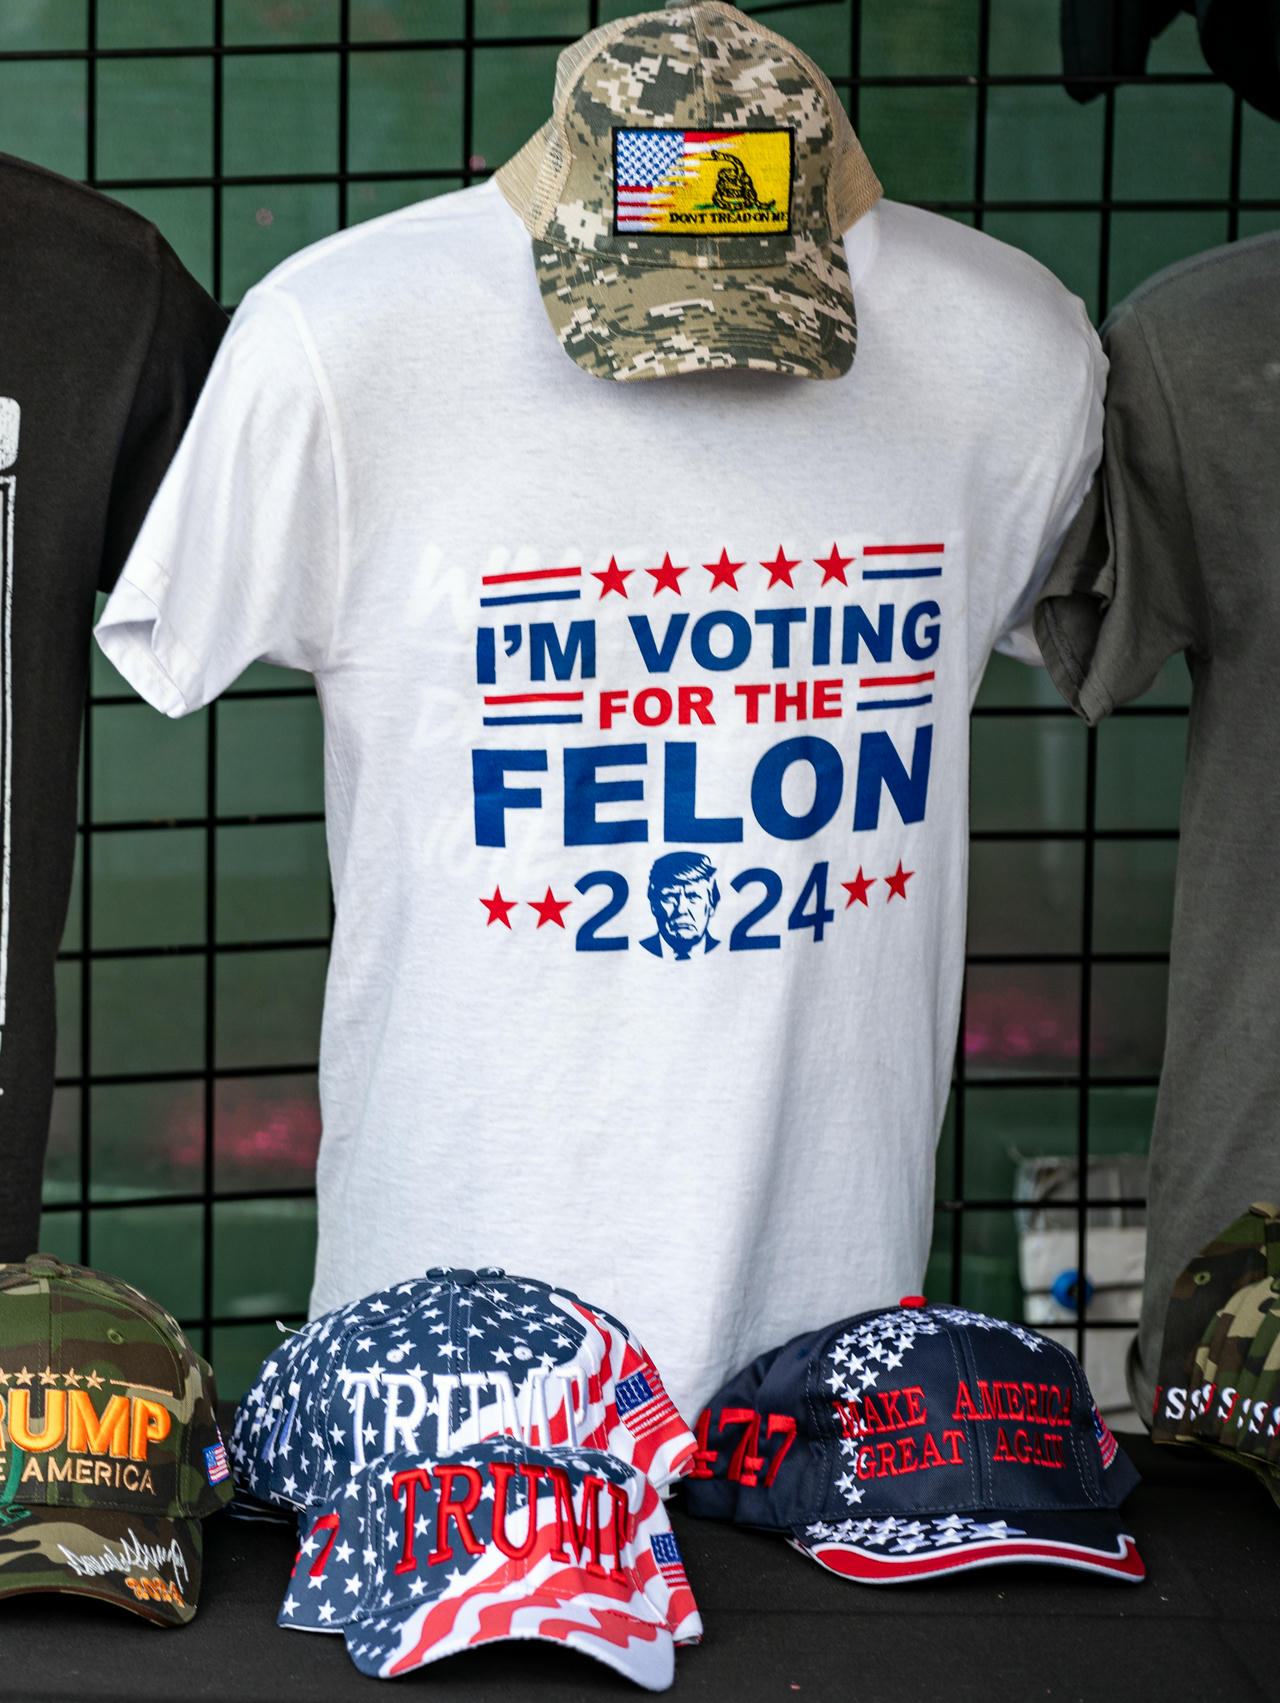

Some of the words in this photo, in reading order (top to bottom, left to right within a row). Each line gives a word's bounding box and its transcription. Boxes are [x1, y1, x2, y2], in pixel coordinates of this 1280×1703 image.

[710, 212, 751, 224] TREAD
[476, 619, 596, 685] I'M
[627, 600, 941, 673] VOTING
[600, 686, 716, 729] FOR
[735, 679, 844, 724] THE
[472, 724, 934, 848] FELON
[341, 1366, 590, 1475] TRUMP
[833, 1385, 929, 1438] MAKE
[951, 1379, 1072, 1425] AMERICA
[21, 1456, 157, 1497] AMERICA
[856, 1428, 966, 1481] GREAT
[991, 1429, 1066, 1469] AGAIN
[392, 1461, 629, 1589] TRUMP
